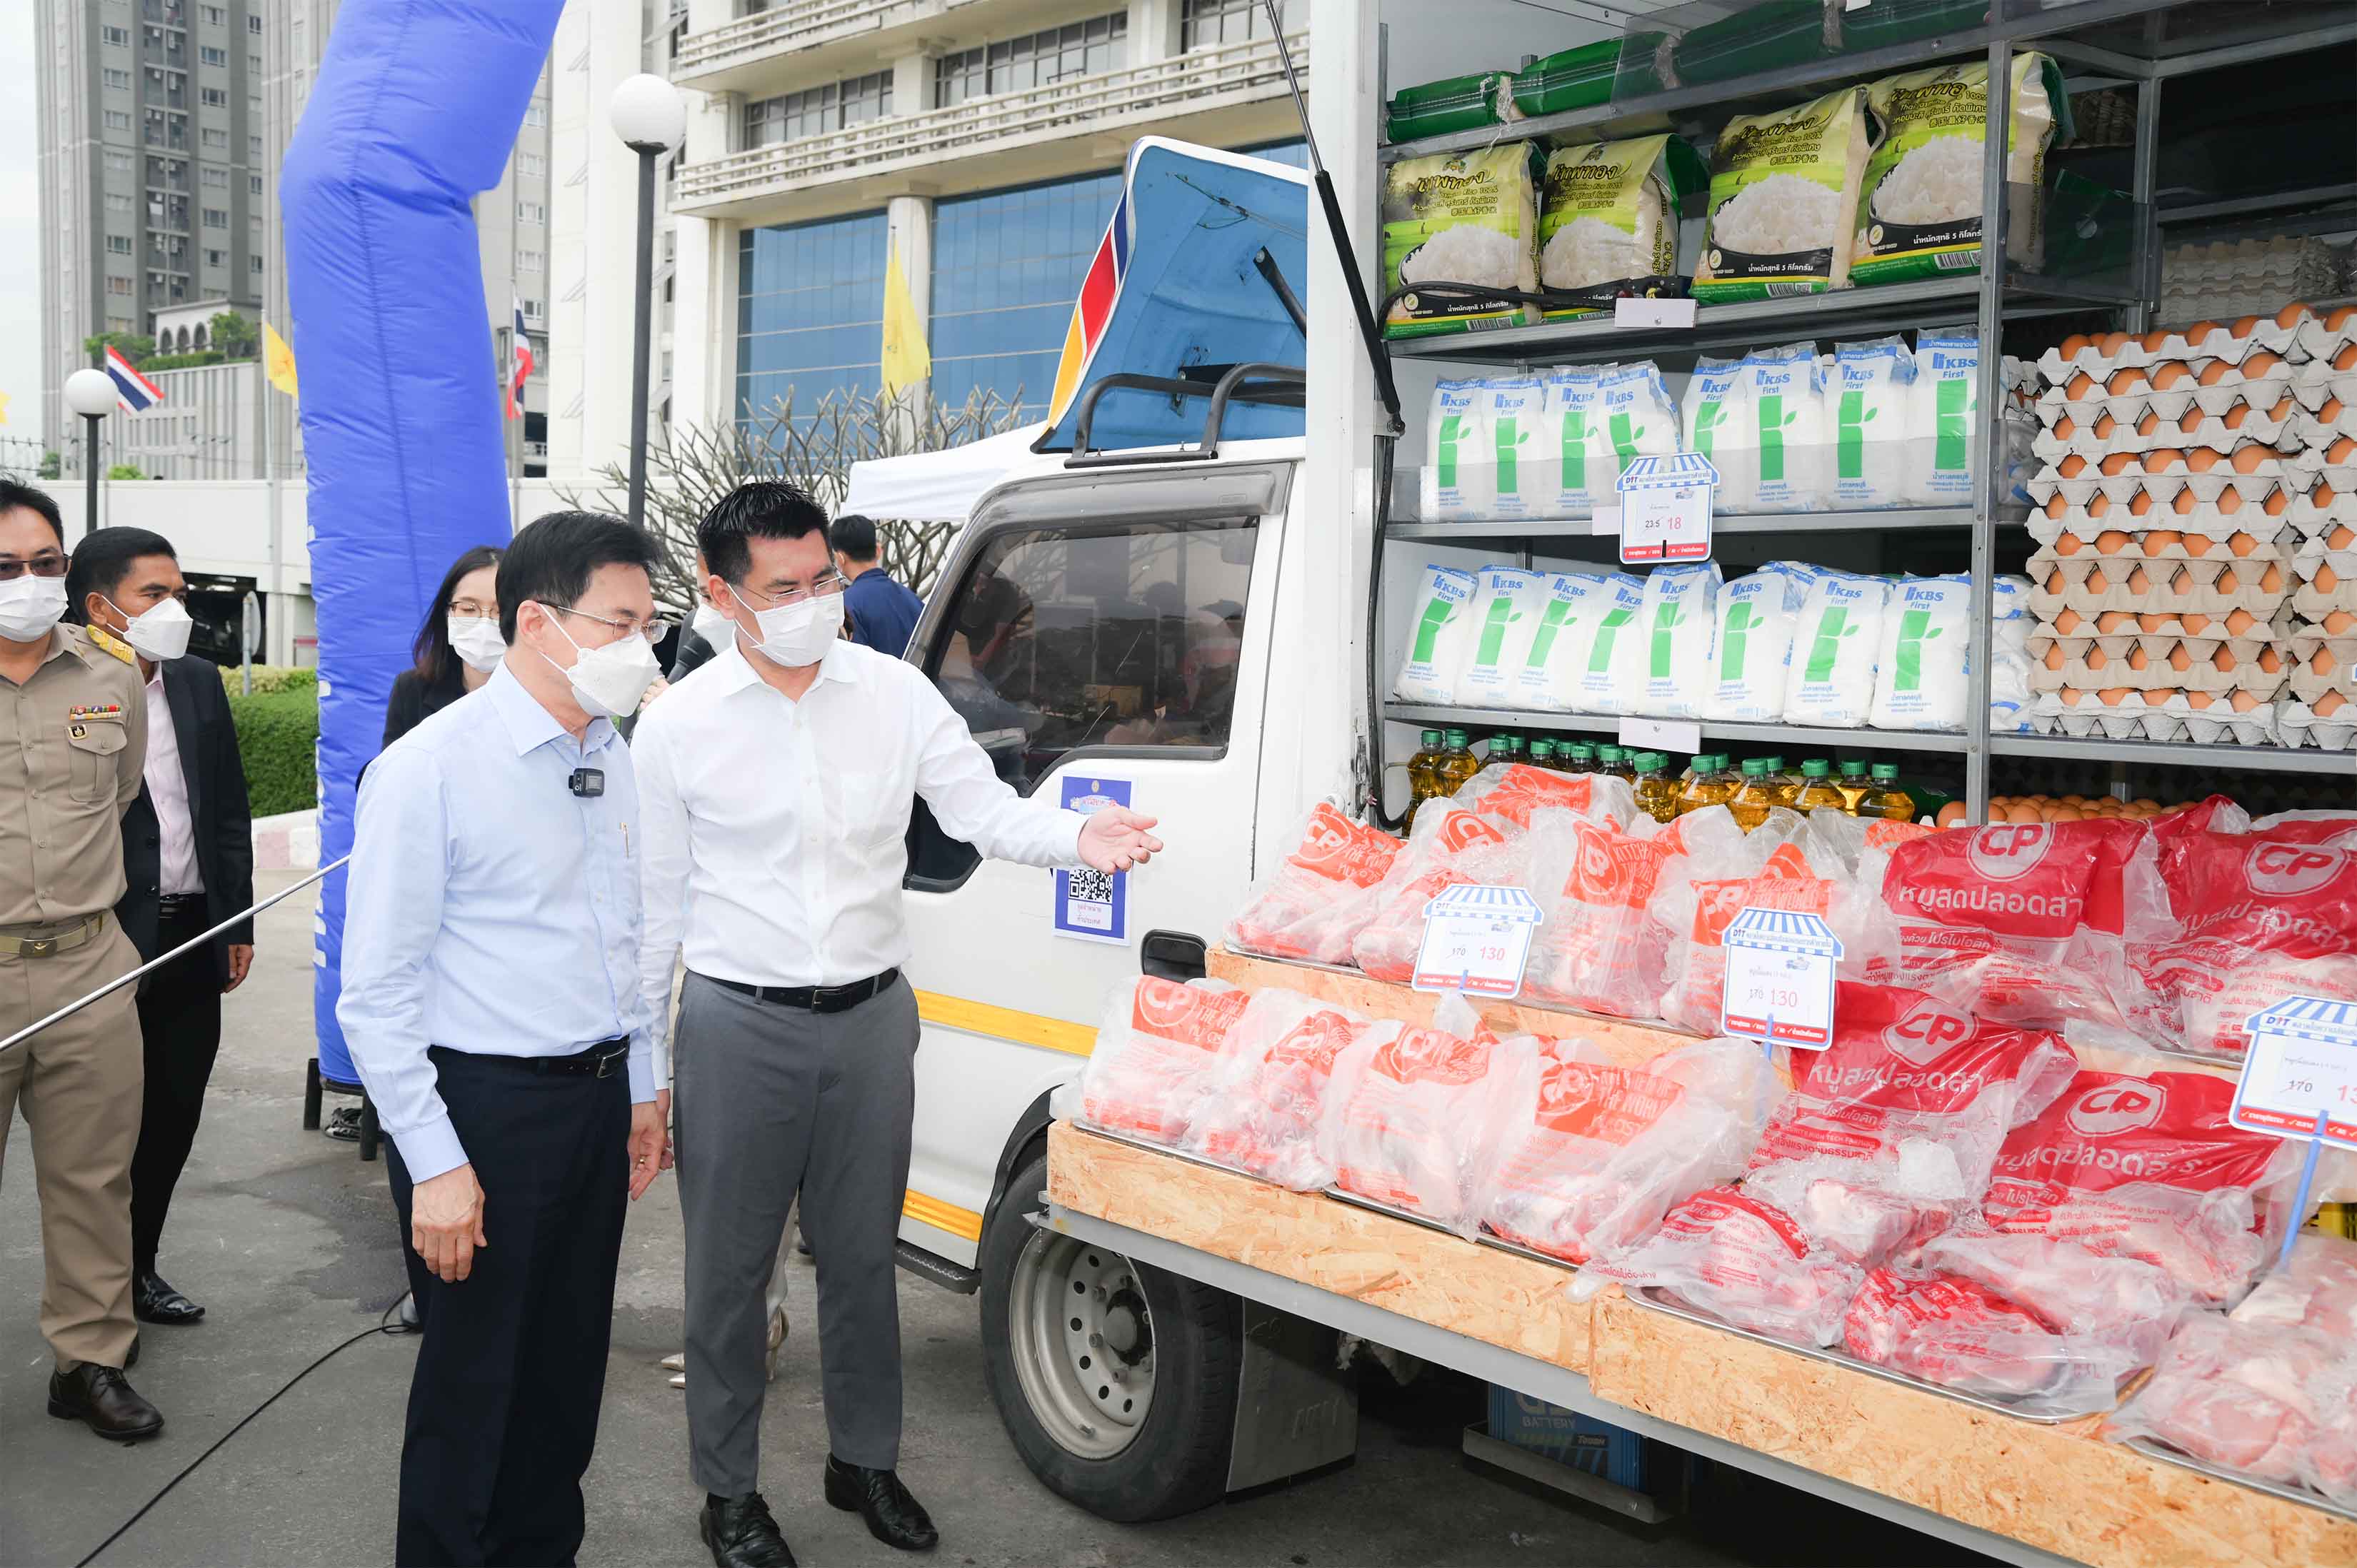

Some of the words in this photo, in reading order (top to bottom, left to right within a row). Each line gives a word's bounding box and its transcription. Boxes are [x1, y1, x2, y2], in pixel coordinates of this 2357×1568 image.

[1945, 358, 1978, 369] KBS
[1766, 373, 1791, 385] KBS
[1850, 369, 1874, 381] KBS
[1763, 386, 1779, 395] First
[1668, 516, 1681, 530] 18
[1442, 583, 1466, 598] KBS
[1501, 579, 1523, 589] KBS
[1563, 584, 1586, 597] KBS
[1739, 583, 1763, 595] KBS
[1437, 591, 1453, 602] First
[1835, 587, 1862, 598] KBS
[1915, 590, 1943, 601] KBS
[1626, 595, 1642, 605] KB
[1305, 820, 1346, 848] CP
[1978, 825, 2043, 857] CP
[1586, 845, 1609, 878] CP
[2256, 845, 2335, 876] CP
[1703, 885, 1748, 914] CP
[1479, 946, 1506, 960] 130
[1146, 981, 1191, 1011] CP
[1771, 988, 1798, 1007] 130
[2266, 1016, 2290, 1027] DIT
[1895, 1012, 1965, 1046] CP
[2289, 1079, 2313, 1092] 170
[2079, 1090, 2152, 1115] CP
[1522, 1416, 1576, 1428] BATTERY
